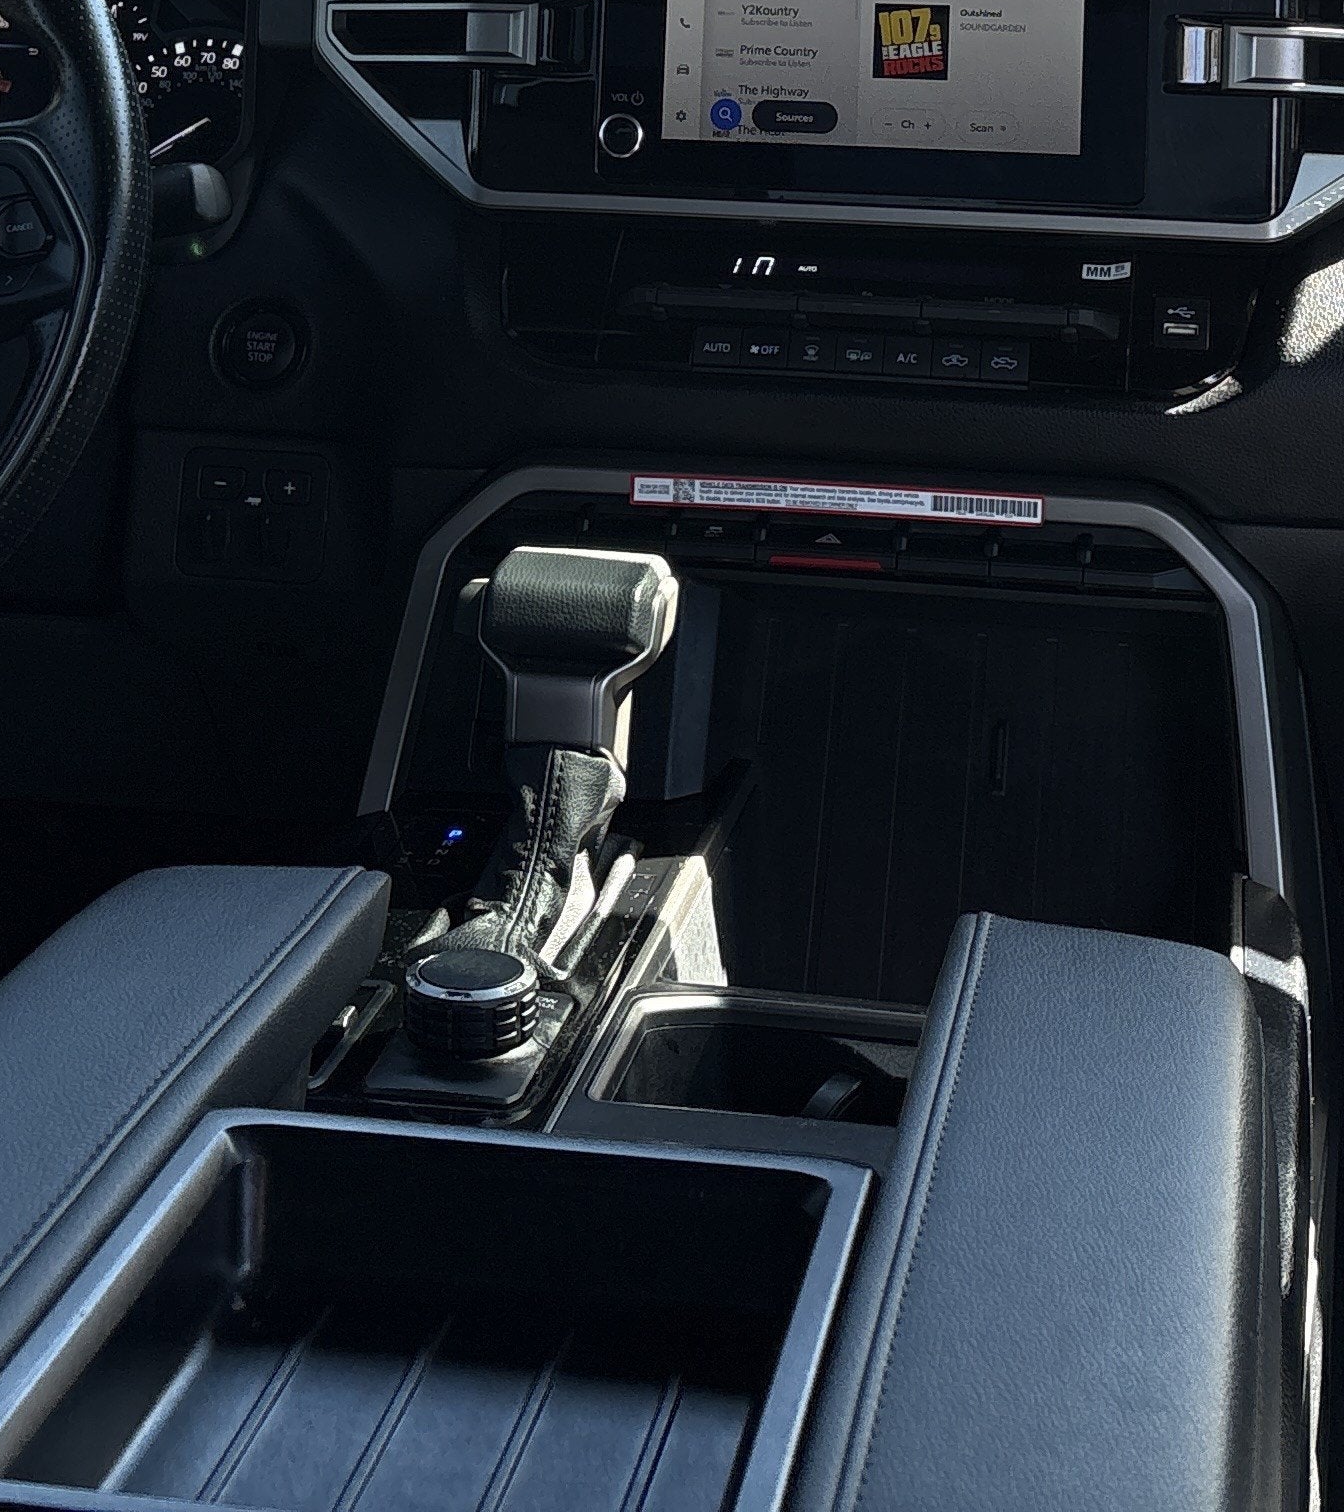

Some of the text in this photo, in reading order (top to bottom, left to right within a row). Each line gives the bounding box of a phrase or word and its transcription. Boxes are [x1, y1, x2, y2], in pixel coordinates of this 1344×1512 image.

[741, 4, 800, 19] Y2Kountry
[739, 44, 819, 59] Prime Country
[888, 41, 943, 59] EAGLE
[173, 55, 192, 67] 60
[200, 51, 217, 64] 70
[221, 57, 240, 70] 80
[150, 65, 168, 78] 50
[883, 55, 944, 76] ROCKS
[738, 84, 758, 95] The
[761, 85, 810, 98] Highway
[775, 112, 814, 123] Sources
[900, 119, 915, 130] Ch
[969, 122, 994, 133] Scan
[1085, 266, 1112, 278] MM
[247, 330, 278, 341] ENGINE
[246, 341, 276, 352] START
[702, 341, 731, 353] AUTO
[760, 345, 781, 356] OFF
[247, 352, 273, 363] STOP
[896, 352, 918, 365] A/C
[448, 829, 463, 838] P
